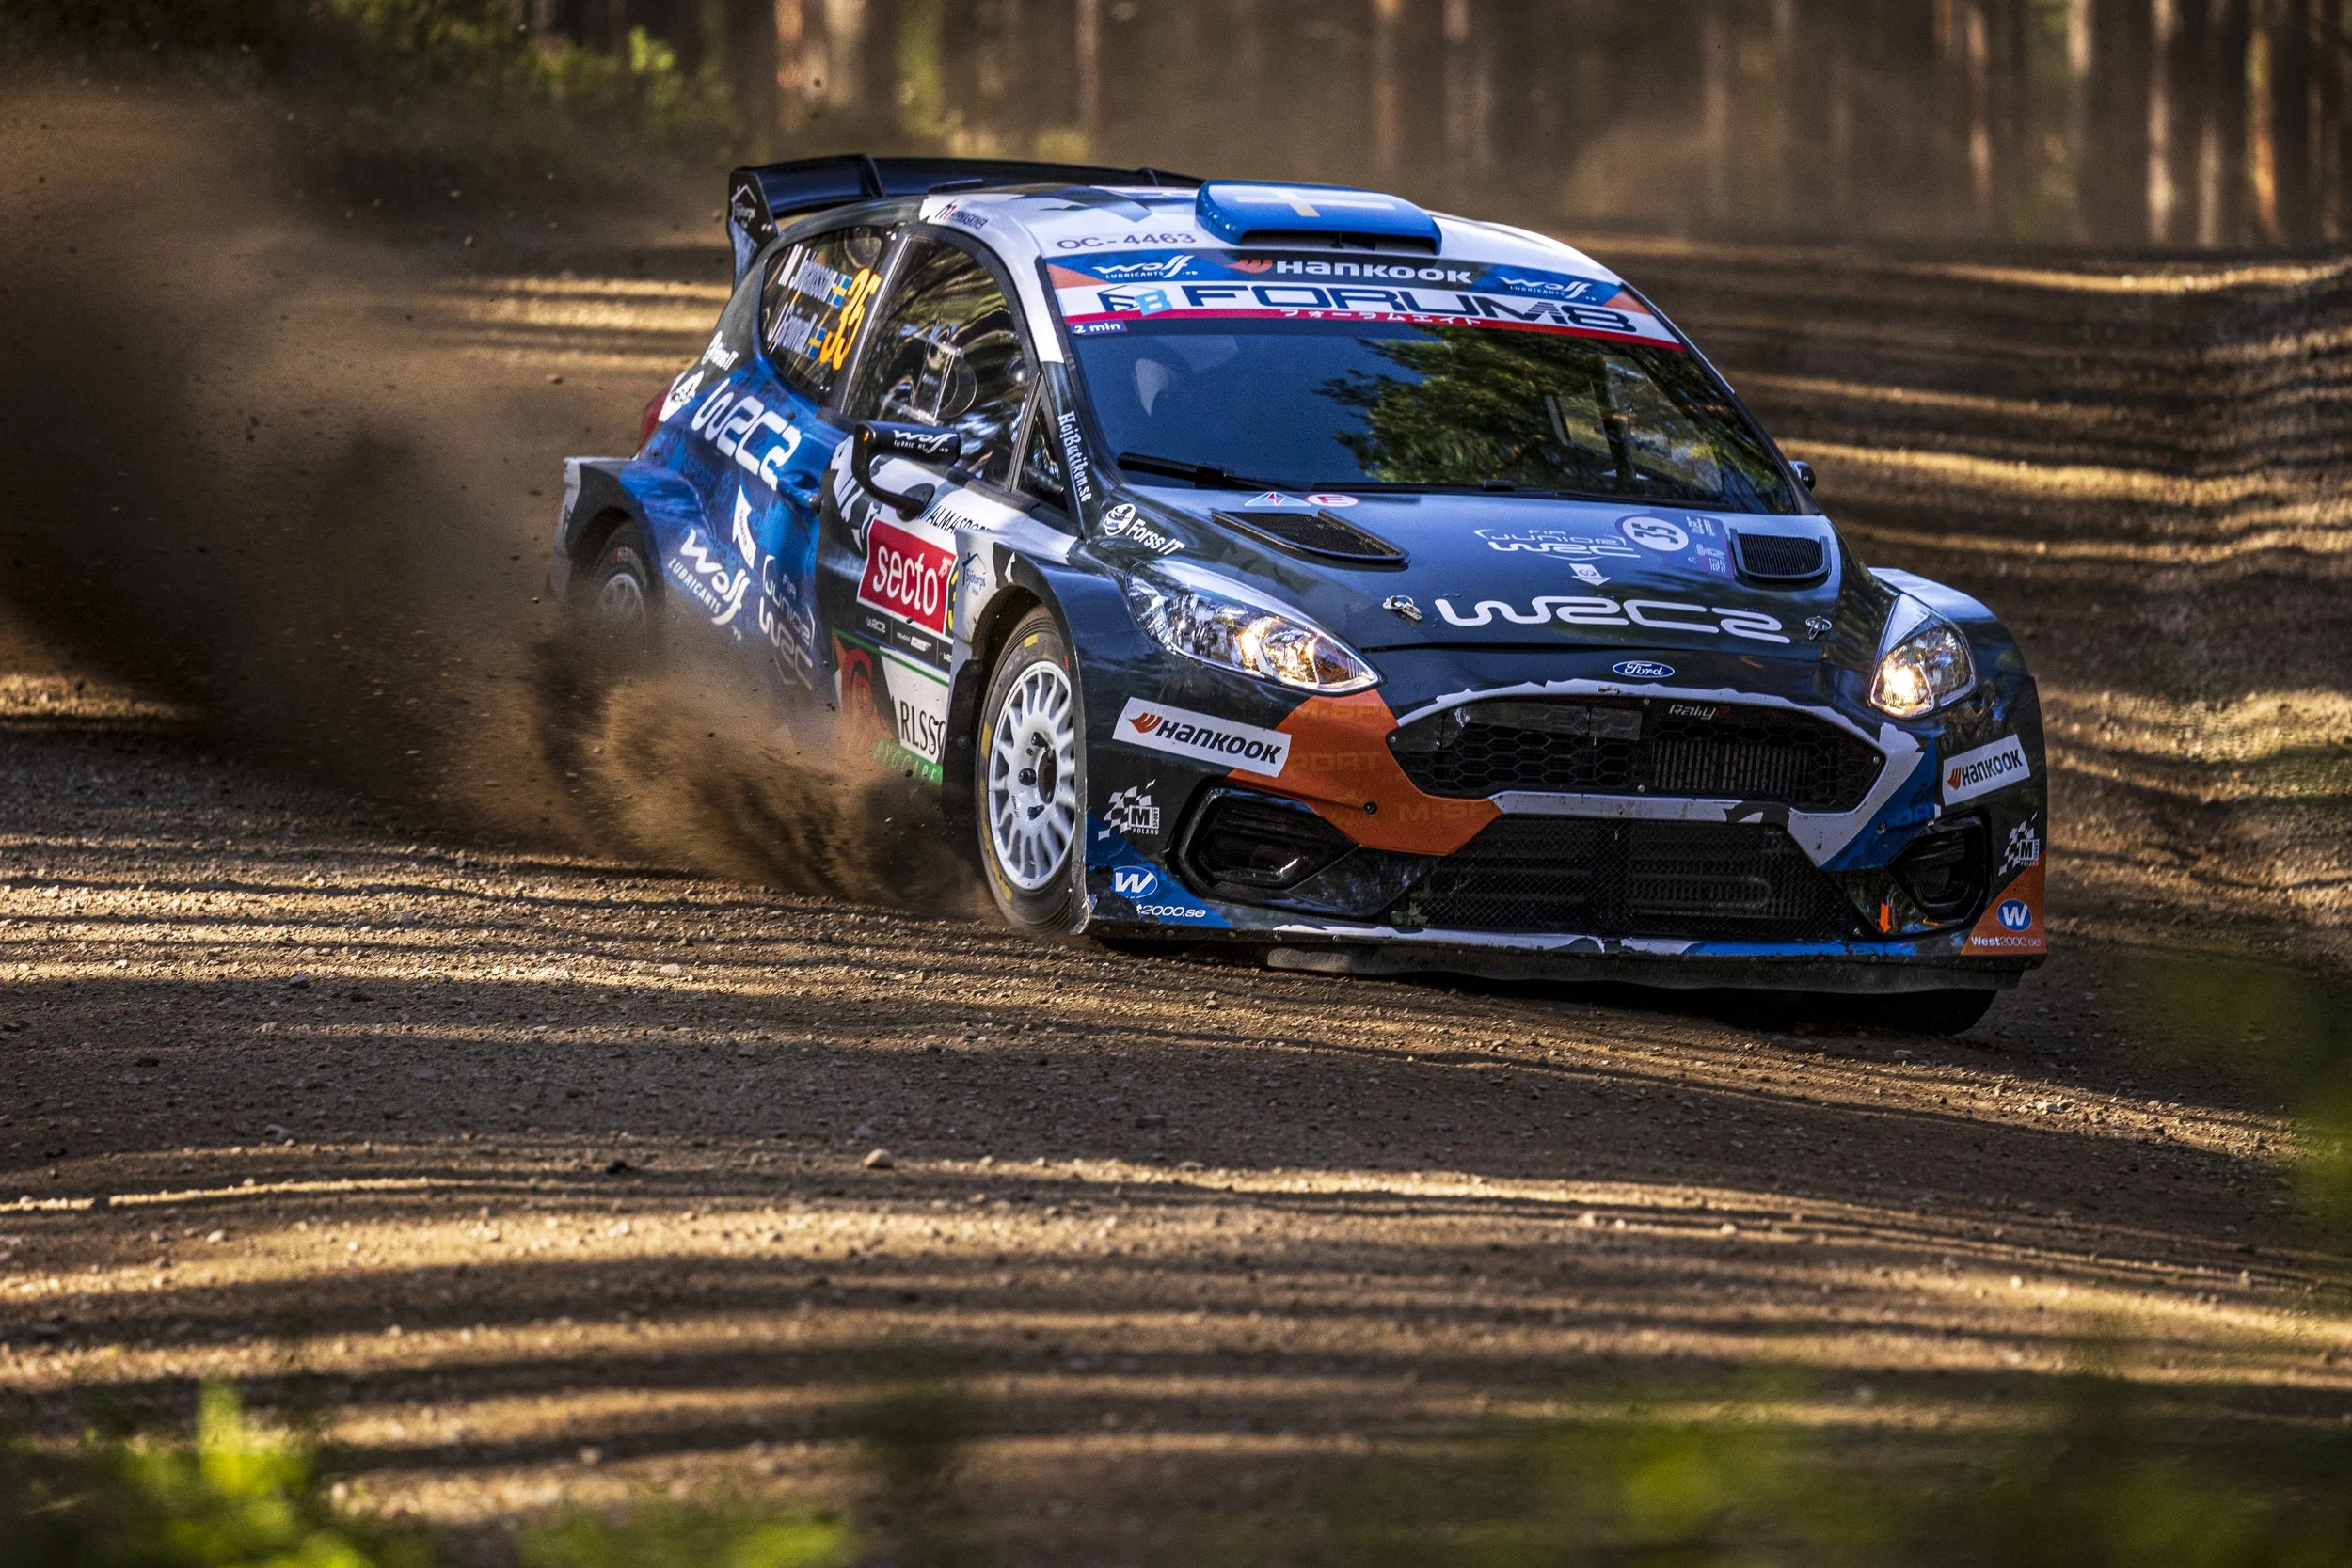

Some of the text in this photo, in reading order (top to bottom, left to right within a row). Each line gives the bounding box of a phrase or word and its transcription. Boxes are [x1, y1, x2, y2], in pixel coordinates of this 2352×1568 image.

[1057, 233, 1197, 250] OC-4463
[1105, 271, 1164, 279] LUBRICANTS
[1509, 285, 1565, 297] LUBRICANTS
[819, 268, 882, 372] 35
[1181, 285, 1638, 333] FORUM8
[1073, 322, 1121, 334] 2 min
[668, 557, 722, 614] LUBRICANTS
[872, 545, 939, 616] secto
[1434, 595, 1791, 644] WRC2
[1624, 662, 1664, 676] Ford
[1115, 872, 1154, 894] W
[2002, 905, 2028, 927] W
[1971, 936, 2042, 947] West2000.se
